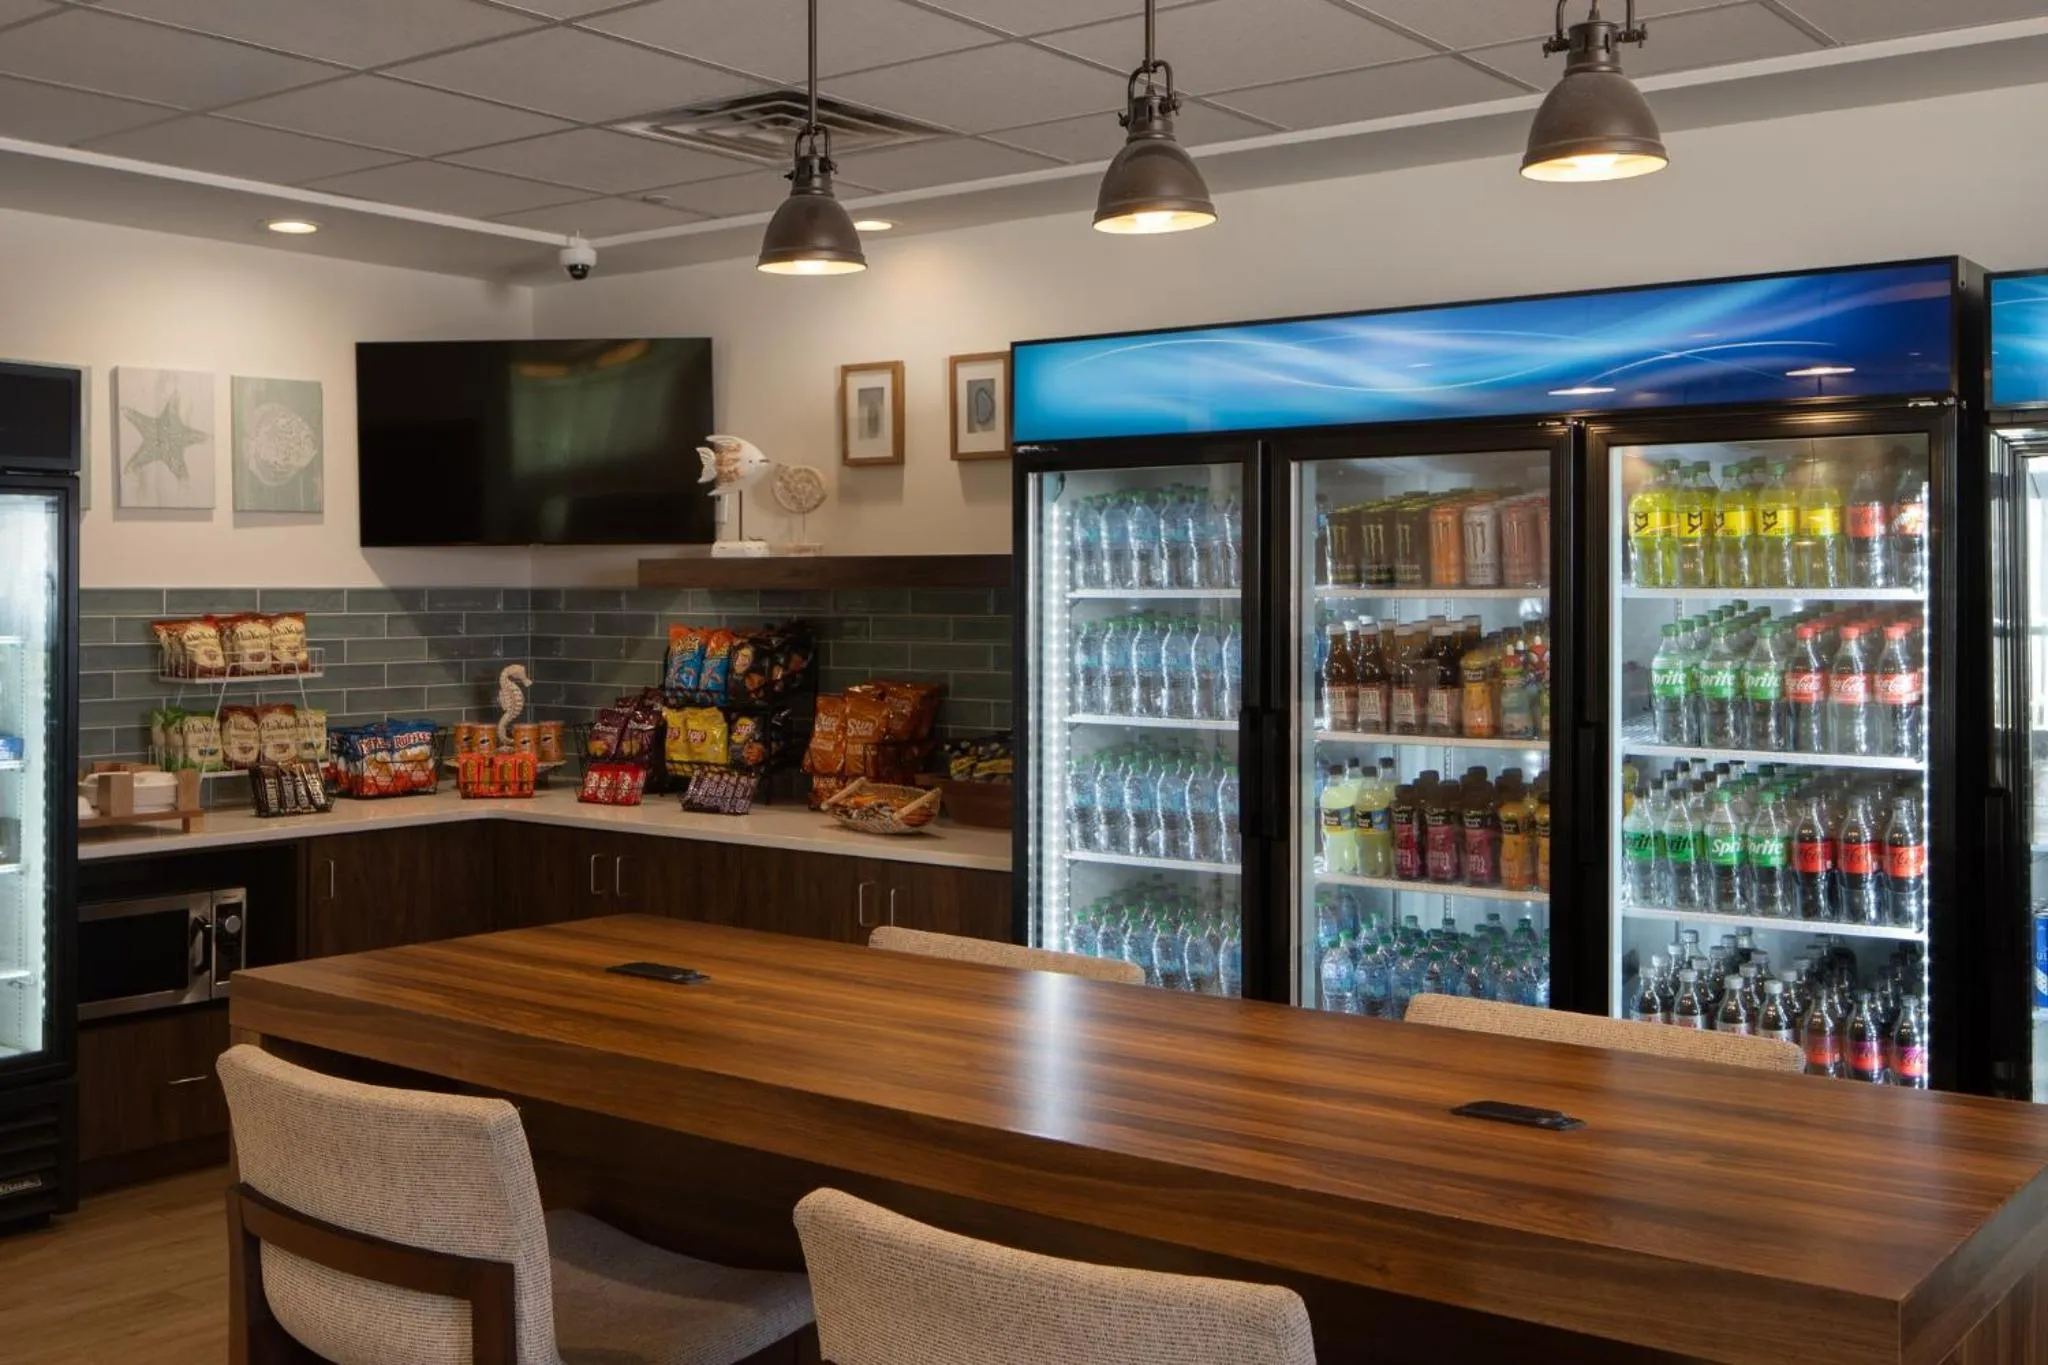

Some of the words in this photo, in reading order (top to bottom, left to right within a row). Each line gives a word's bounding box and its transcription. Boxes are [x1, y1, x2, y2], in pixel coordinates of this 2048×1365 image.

[1653, 670, 1686, 687] prite
[394, 731, 432, 749] RUFFLES
[1711, 838, 1743, 857] Spri
[1748, 838, 1784, 856] prite
